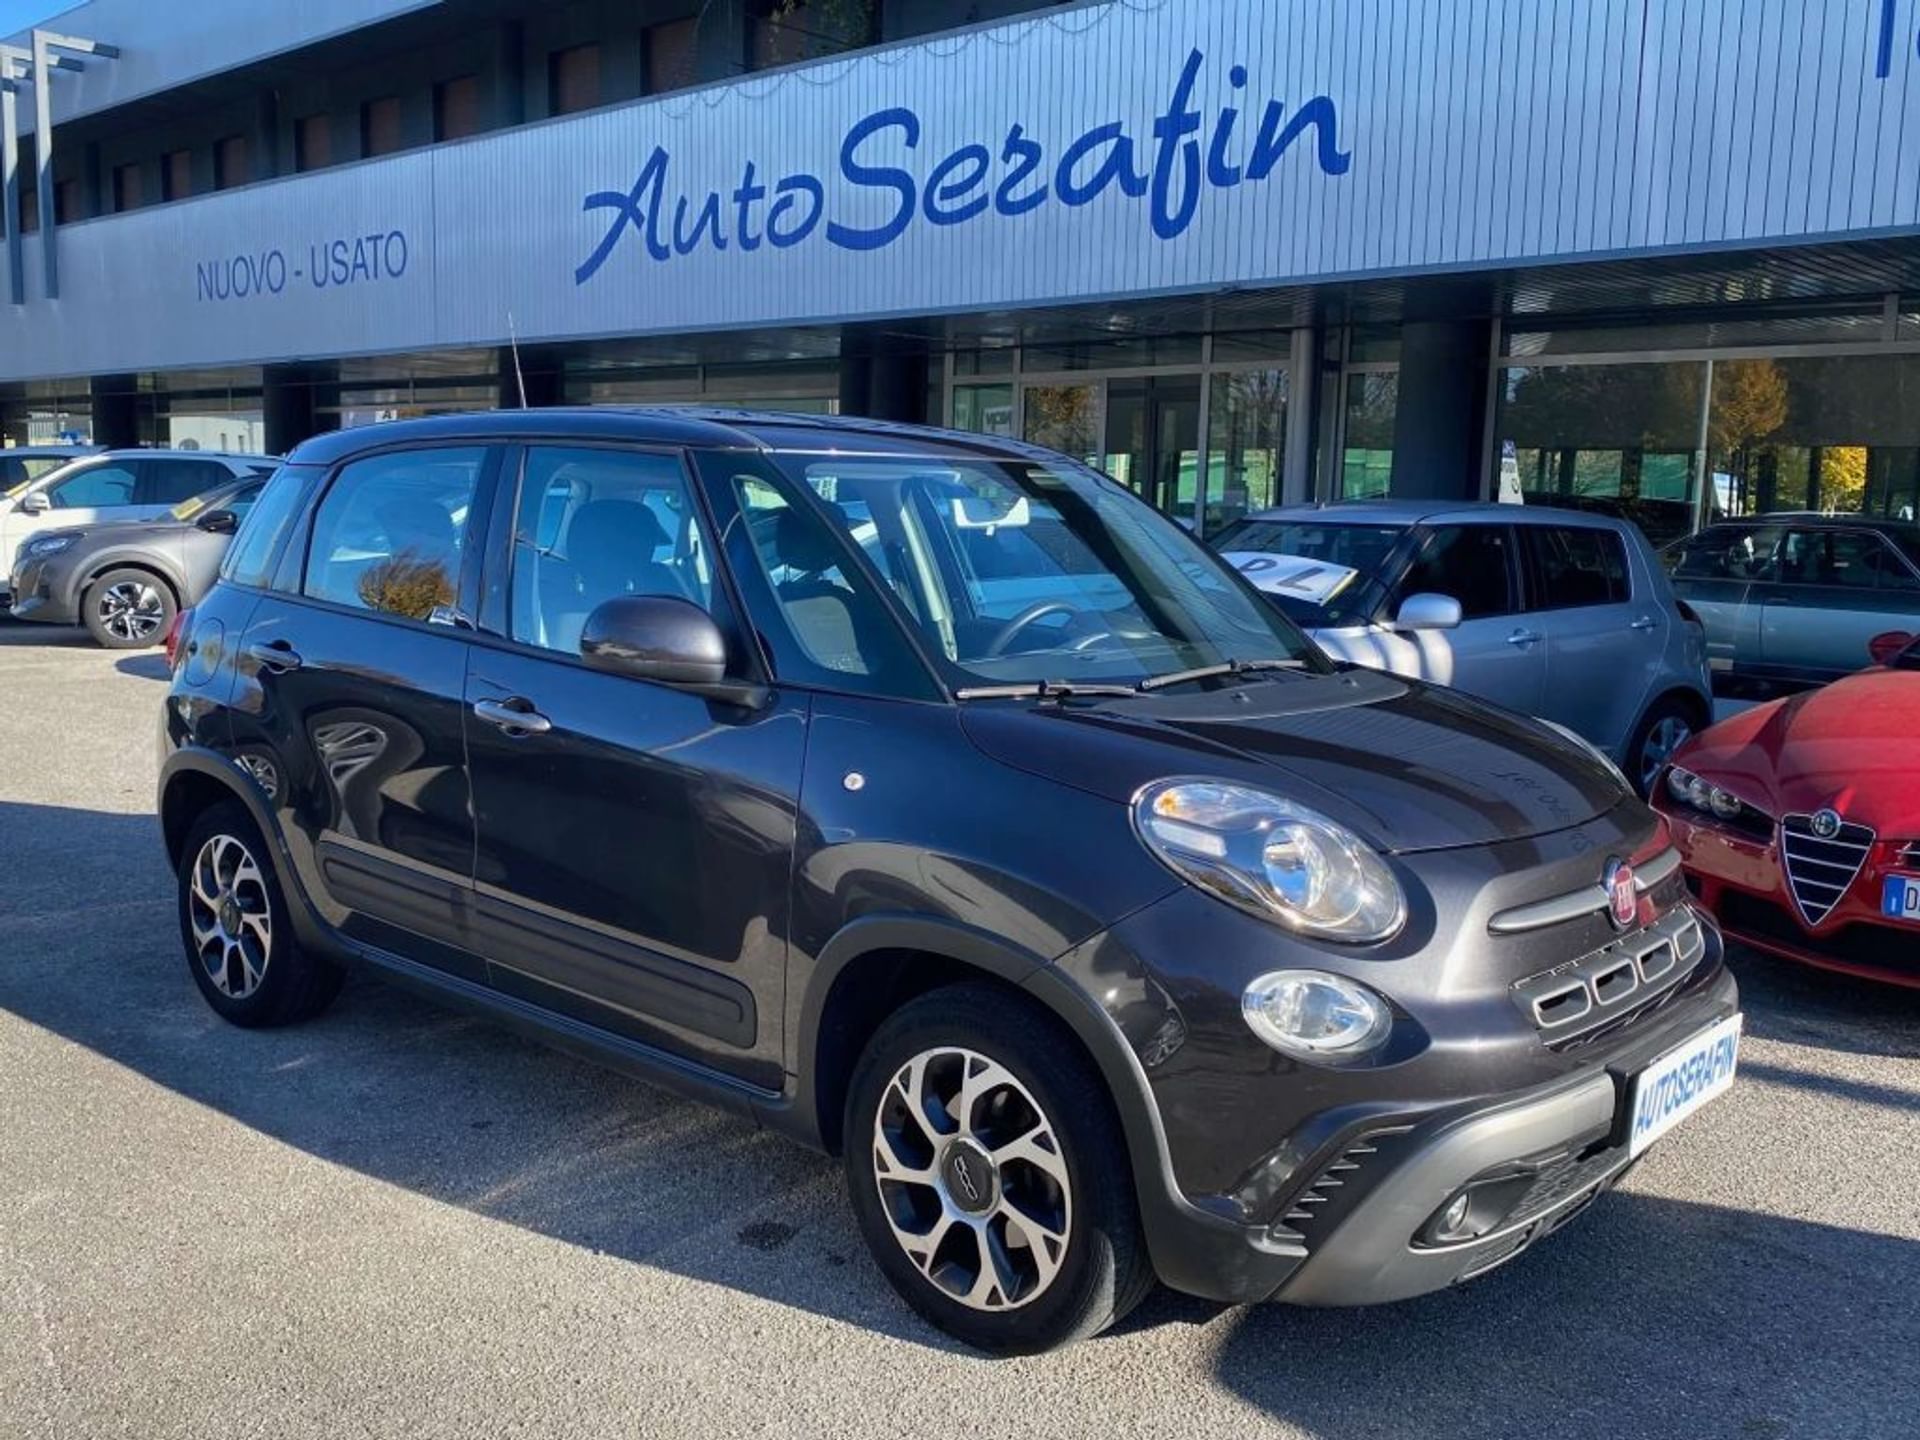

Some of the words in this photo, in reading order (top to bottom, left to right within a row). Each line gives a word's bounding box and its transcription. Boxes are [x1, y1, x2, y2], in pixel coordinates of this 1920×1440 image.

[575, 47, 1352, 285] AutoSerafin
[197, 250, 286, 301] NUOVO
[311, 230, 407, 288] USATO
[1633, 1031, 1738, 1141] AUTOSERAFIN
